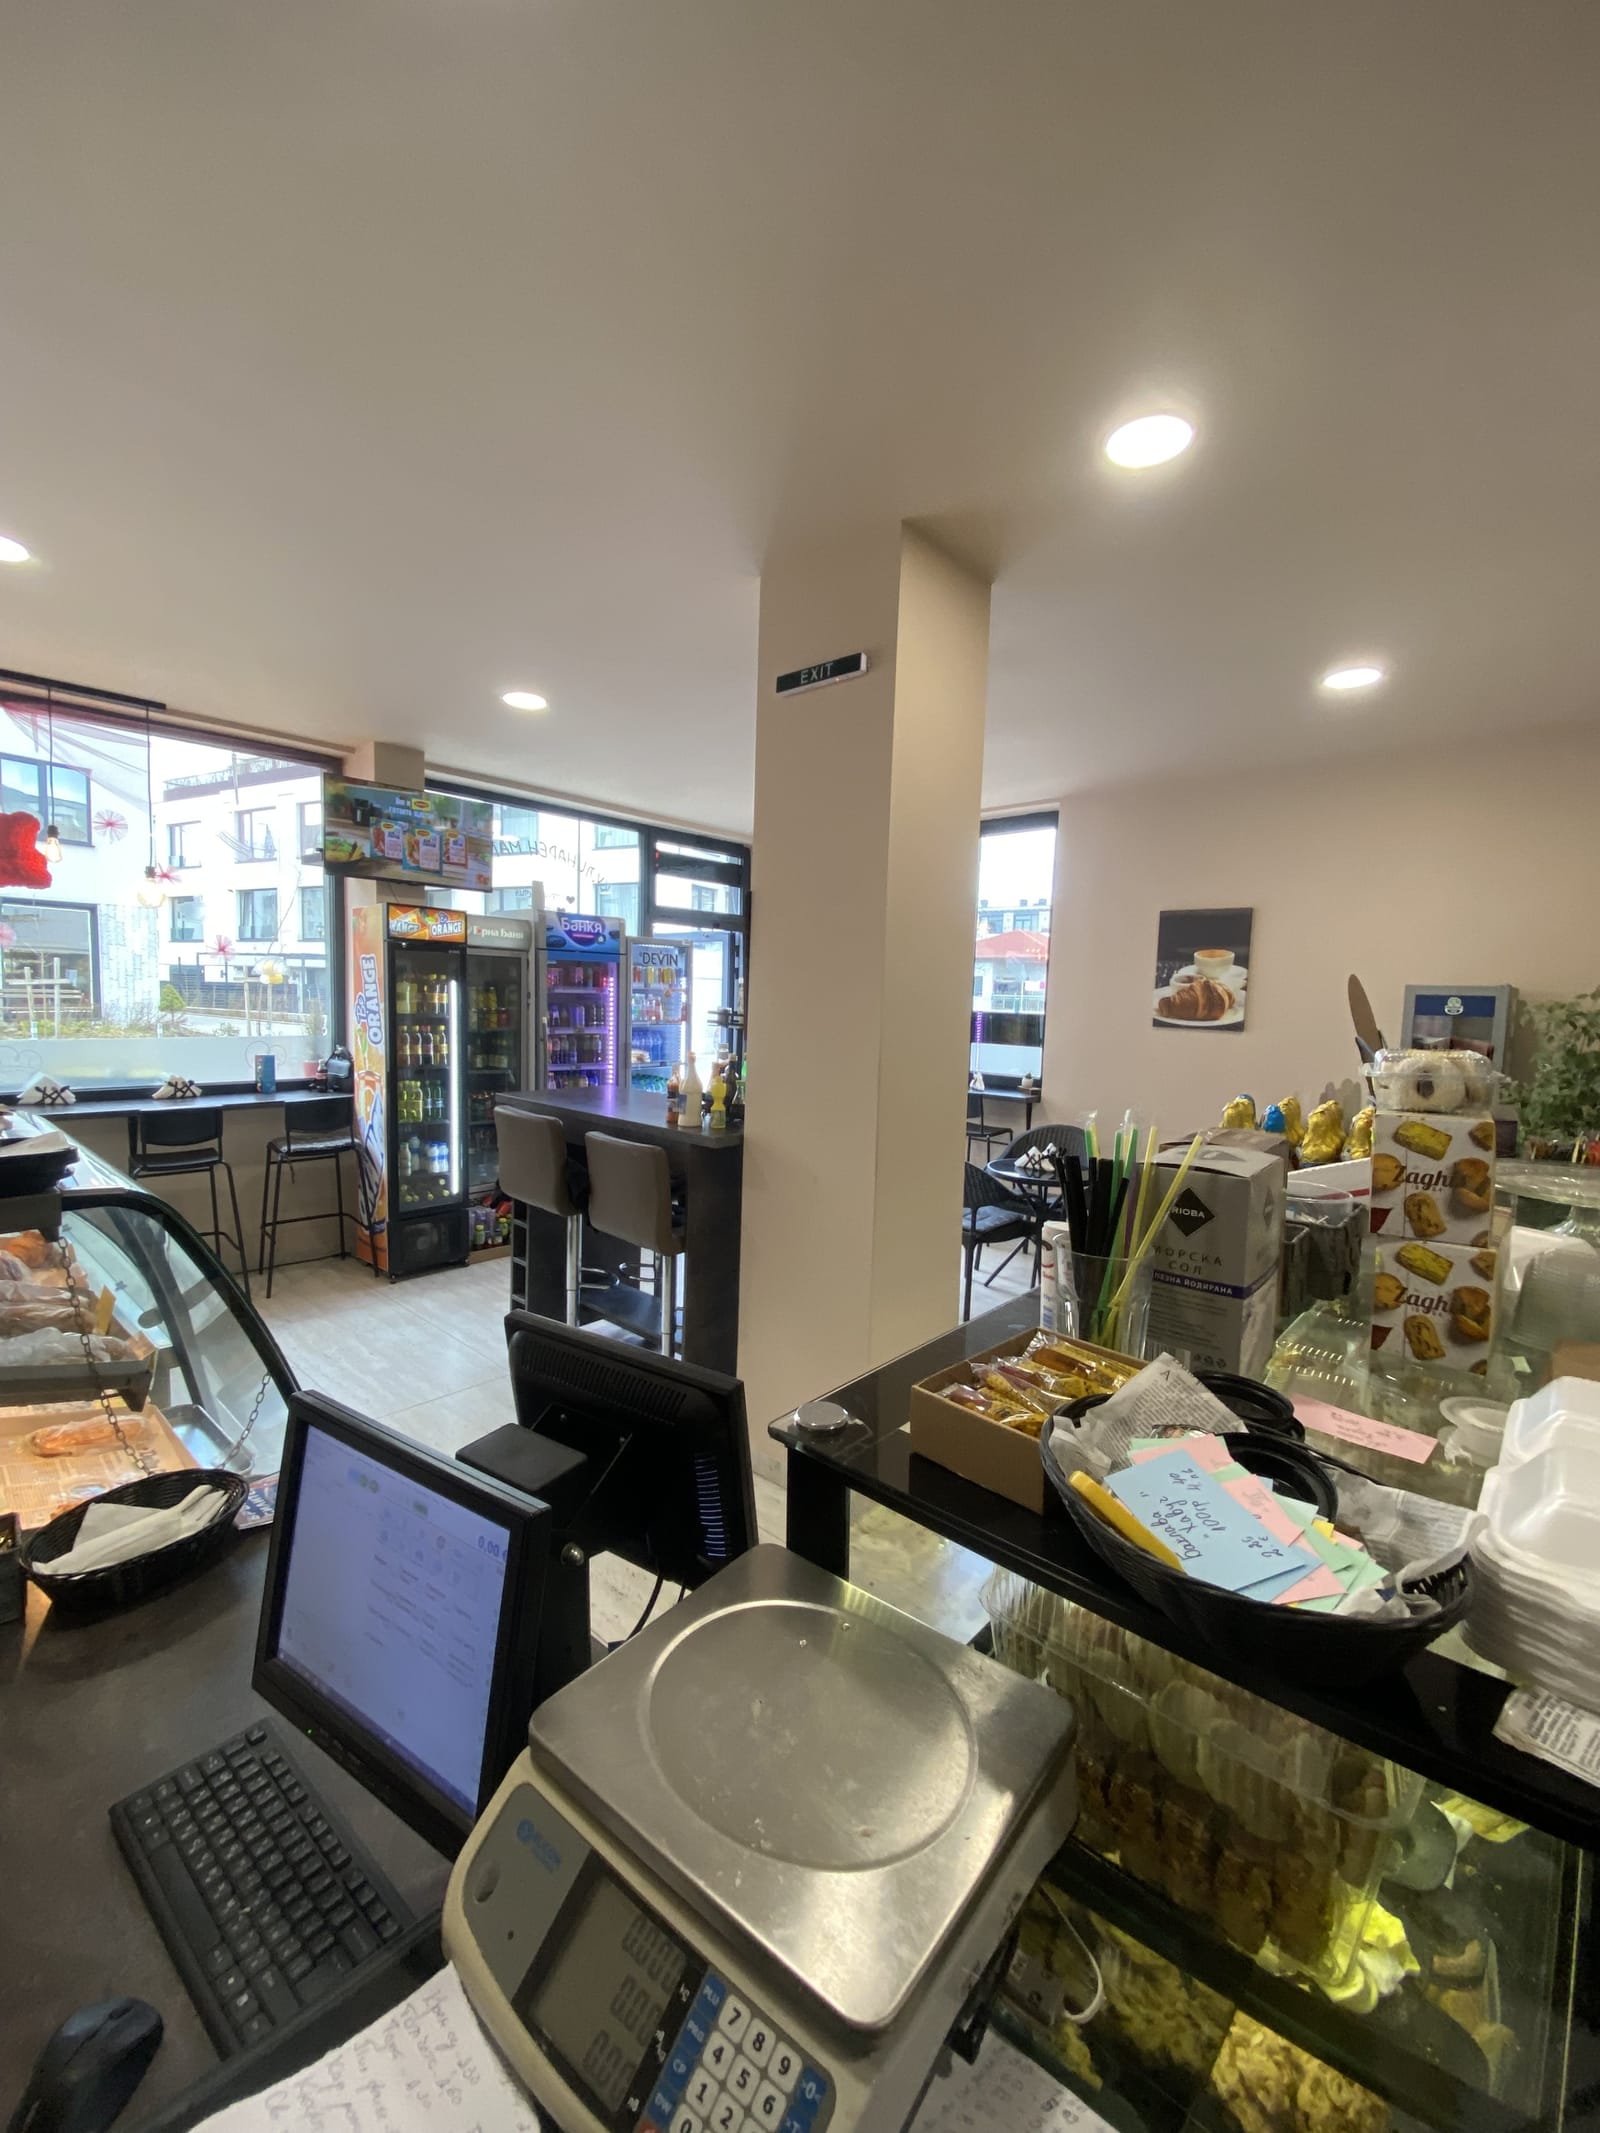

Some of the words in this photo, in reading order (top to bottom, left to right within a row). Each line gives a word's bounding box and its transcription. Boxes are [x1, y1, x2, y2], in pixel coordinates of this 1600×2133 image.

[800, 662, 833, 685] EXIT
[431, 920, 463, 937] ORANGE
[641, 951, 679, 968] DEVIN
[361, 954, 383, 1045] ORANGE
[1168, 1260, 1202, 1275] СОЛ
[1184, 1278, 1233, 1295] ЙОДИРАНА
[703, 1985, 720, 2005] PLU
[728, 2007, 741, 2025] 7
[753, 2032, 765, 2052] 8
[778, 2056, 791, 2075] 9
[712, 2046, 724, 2065] 4
[736, 2068, 750, 2089] 5
[763, 2095, 776, 2114] 6
[696, 2083, 707, 2103] 1
[720, 2107, 733, 2130] 2
[680, 2118, 692, 2133] 0
